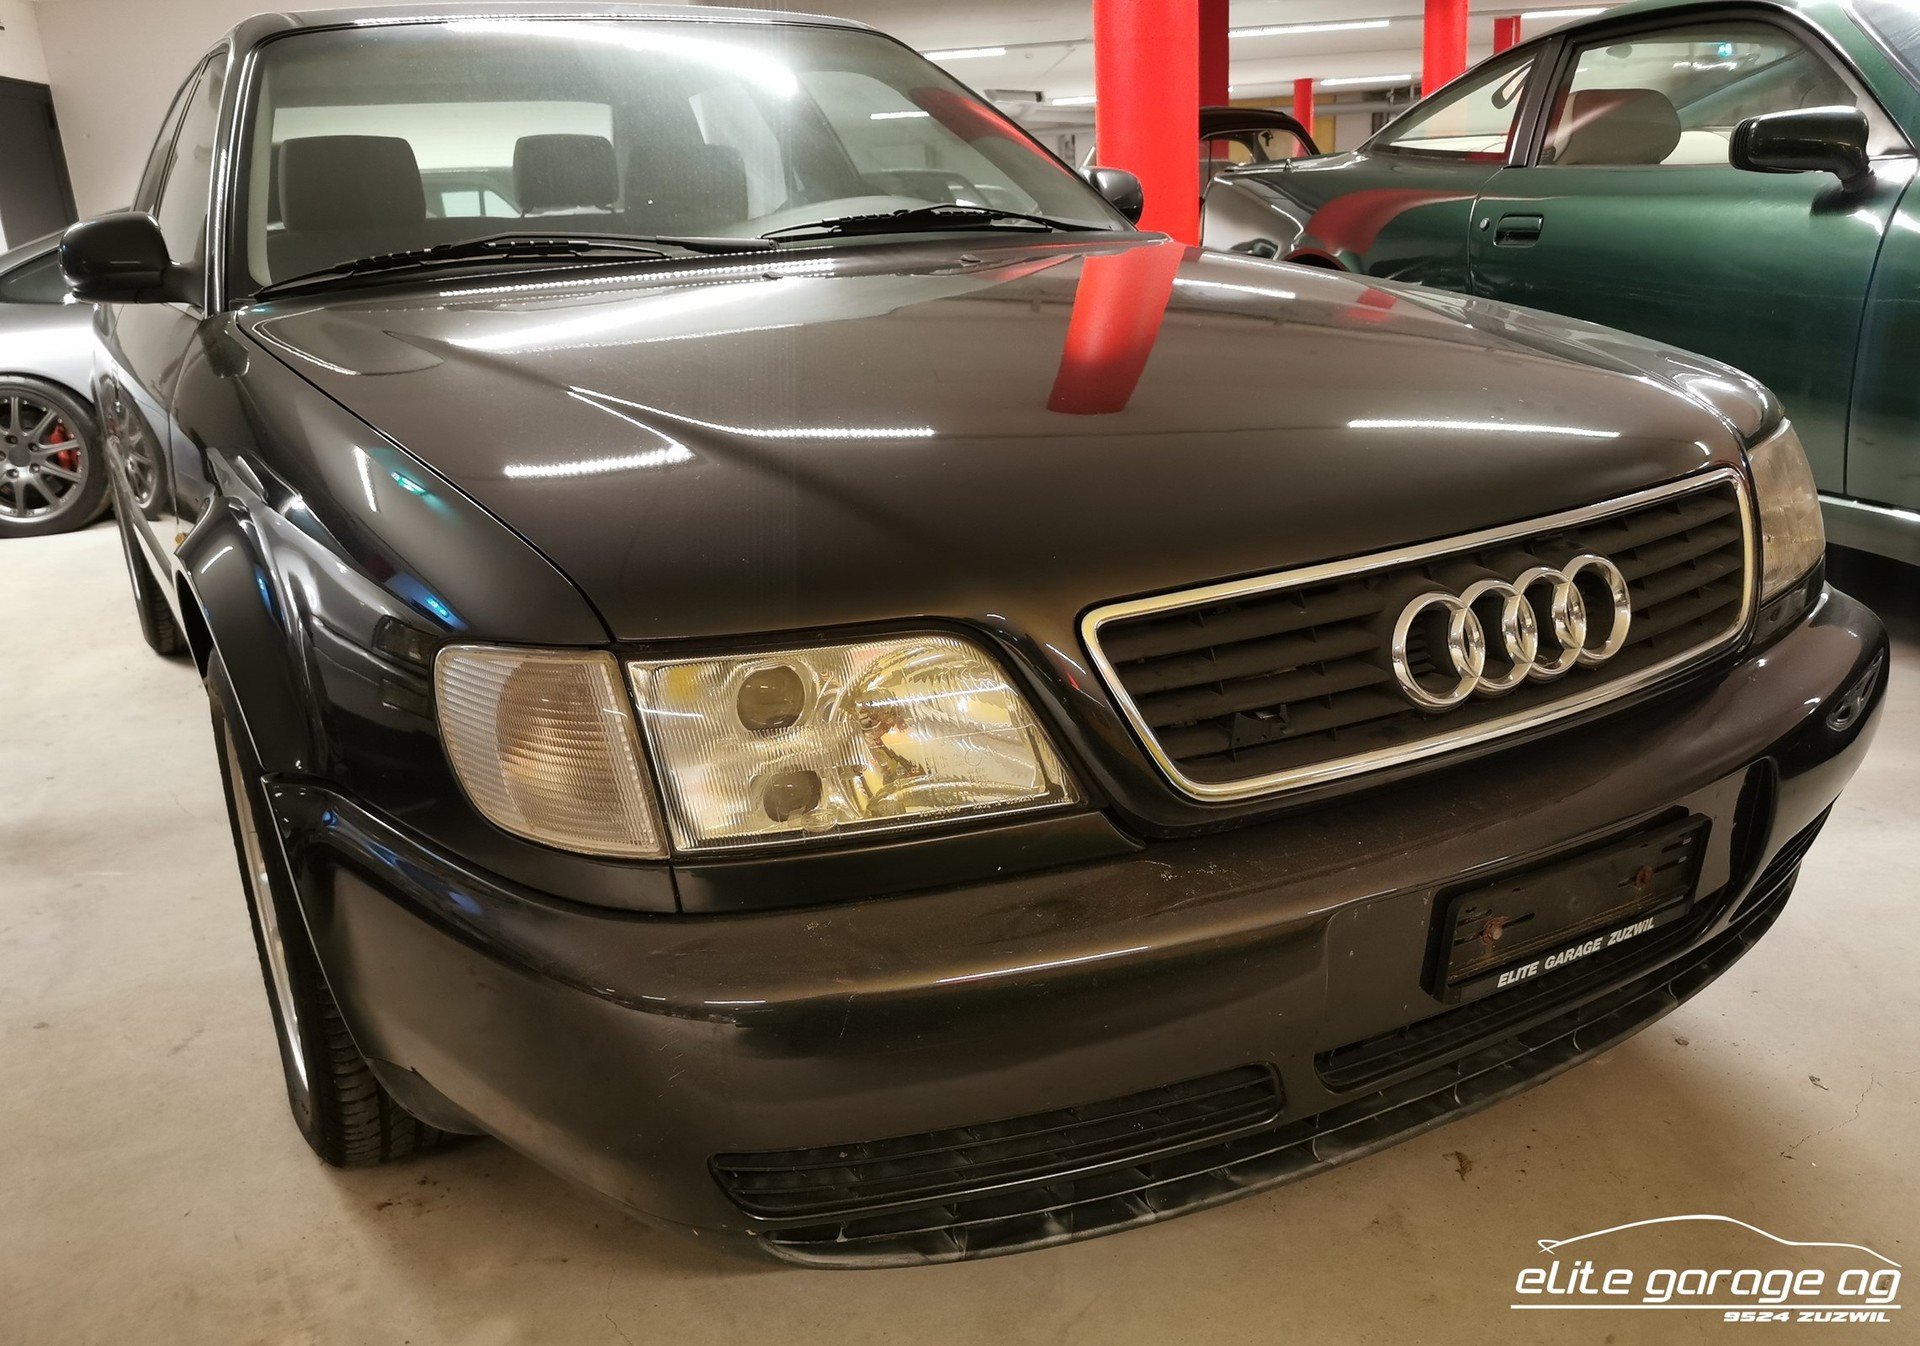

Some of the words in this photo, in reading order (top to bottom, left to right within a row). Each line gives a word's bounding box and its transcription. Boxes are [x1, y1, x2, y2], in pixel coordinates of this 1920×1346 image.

[1496, 960, 1540, 988] ELITE
[1544, 936, 1603, 970] GARAGE
[1606, 916, 1655, 947] ZUZWIL
